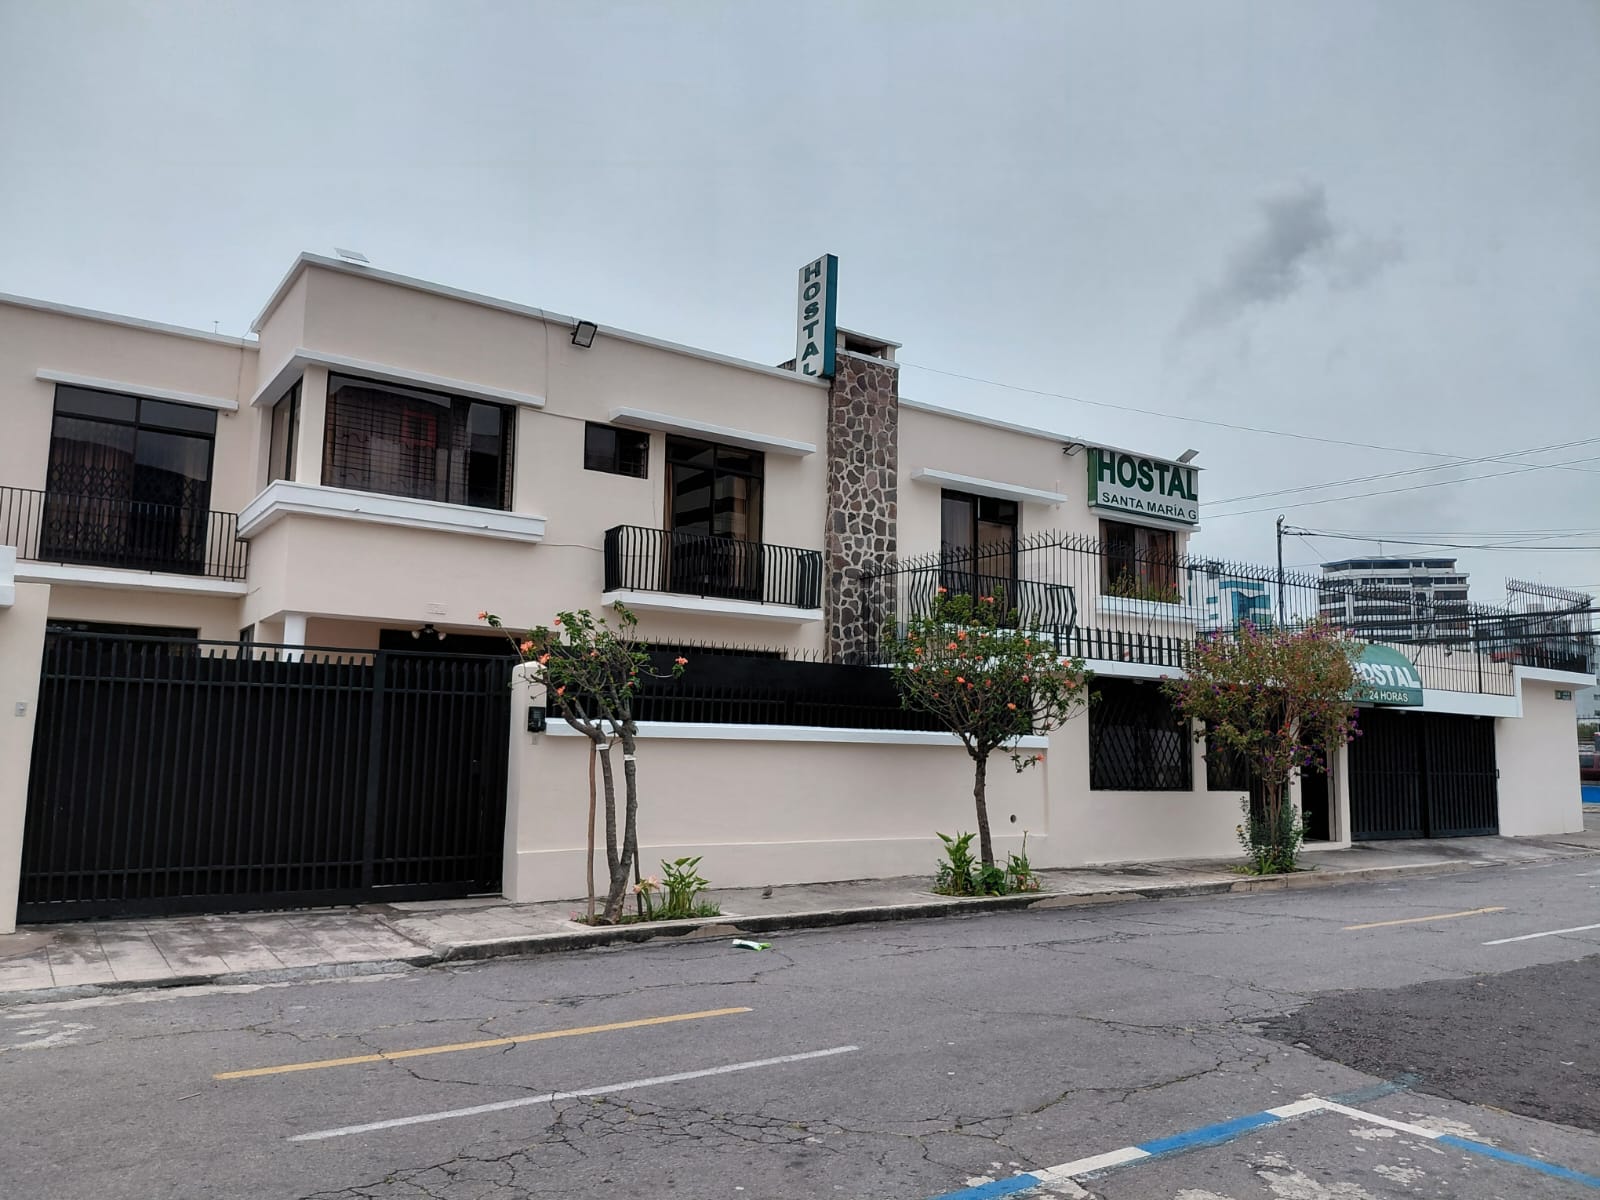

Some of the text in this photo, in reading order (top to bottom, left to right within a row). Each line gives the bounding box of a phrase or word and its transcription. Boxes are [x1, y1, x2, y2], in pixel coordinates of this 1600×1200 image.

[801, 260, 821, 376] HOSTAL
[1098, 448, 1198, 501] HOSTAL
[1102, 492, 1197, 520] SANTA MARÍA G
[1369, 690, 1409, 703] 24 HORAS
